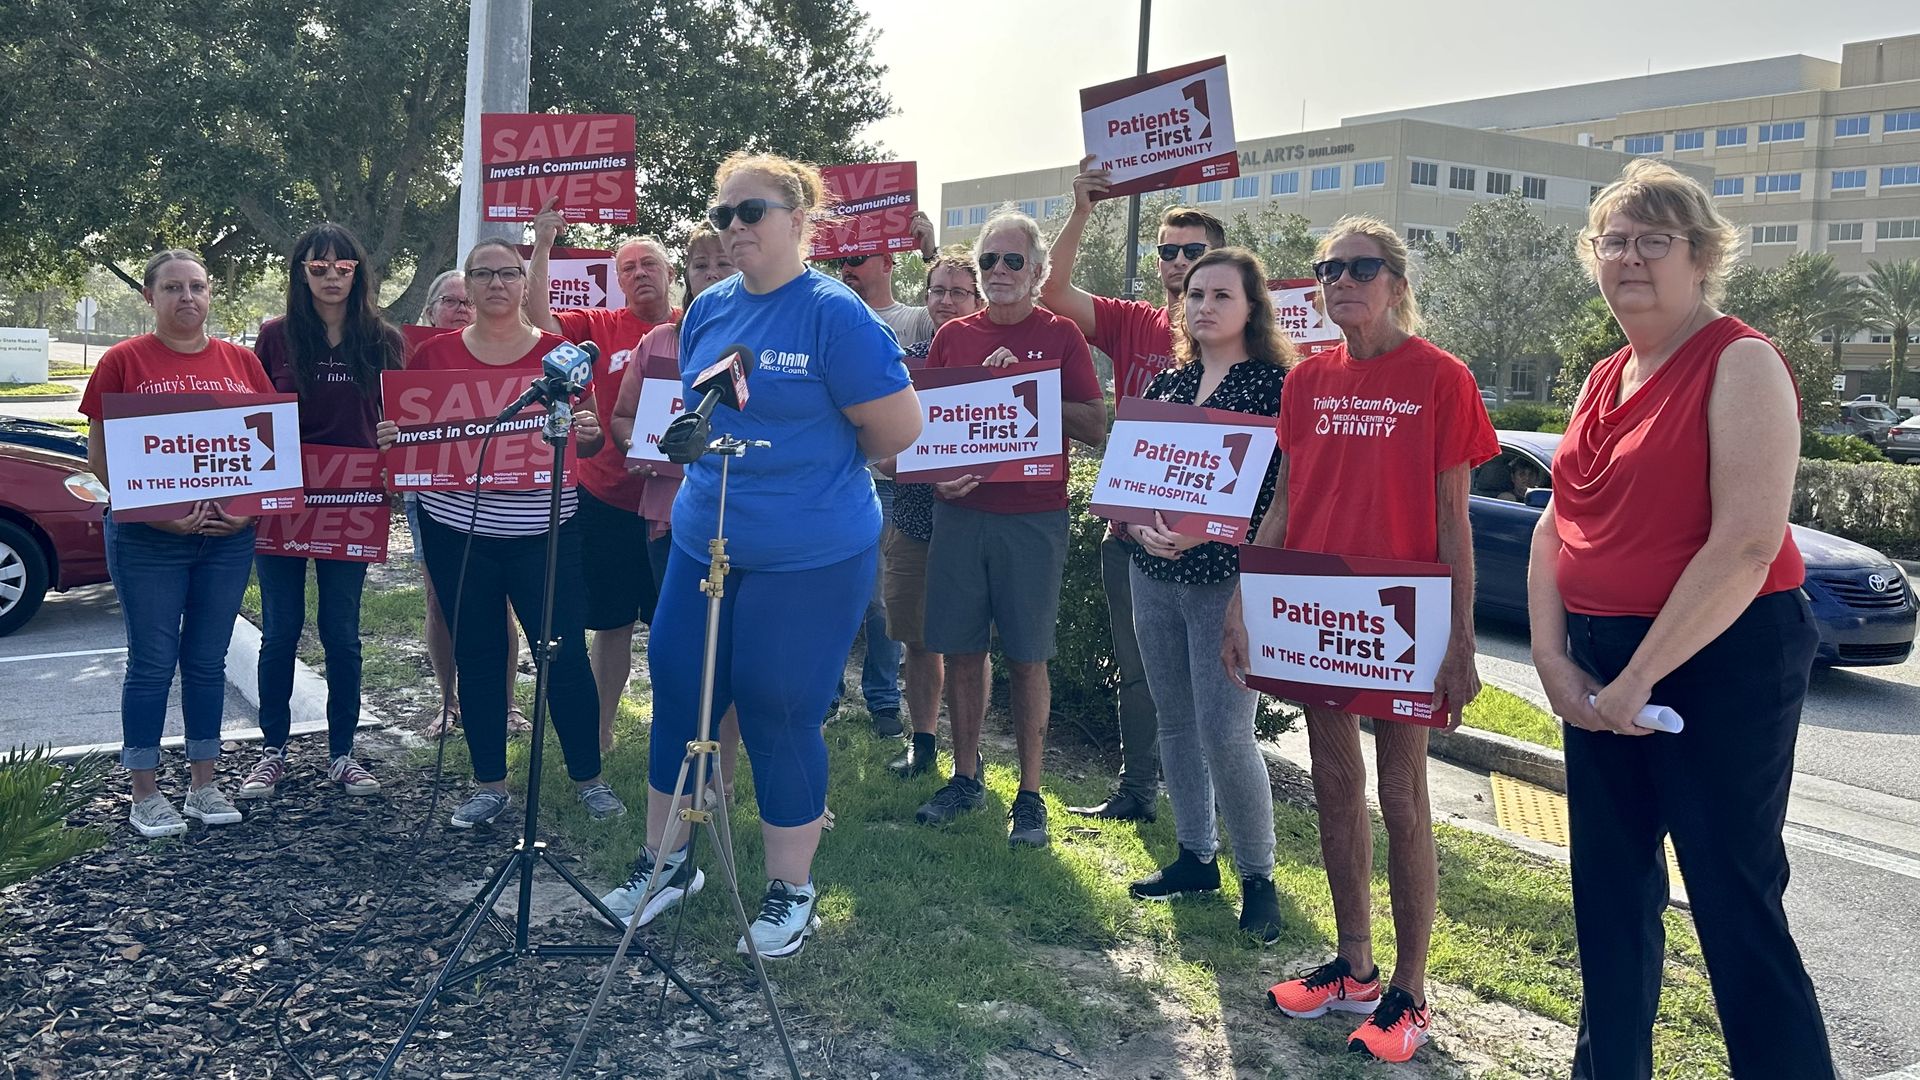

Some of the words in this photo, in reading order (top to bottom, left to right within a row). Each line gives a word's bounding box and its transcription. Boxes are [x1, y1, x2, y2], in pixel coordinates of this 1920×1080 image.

[1108, 108, 1190, 138] Patients
[490, 119, 618, 164] SAVE
[1145, 125, 1192, 150] First
[1102, 160, 1112, 171] IN
[1116, 156, 1138, 168] THE
[1140, 142, 1212, 164] COMMUNITY
[1262, 144, 1304, 164] ARTS
[1308, 144, 1354, 158] BUILDING
[490, 167, 525, 178] Invest
[528, 164, 539, 174] in
[543, 157, 627, 172] Communities
[496, 171, 623, 209] LIVES
[838, 195, 910, 215] Communities
[1135, 282, 1143, 290] 52
[550, 291, 590, 306] First
[760, 362, 780, 372] Pasco
[782, 366, 808, 376] County
[136, 374, 186, 394] Trinity's
[186, 374, 223, 391] Team
[928, 403, 1018, 422] Patients
[1313, 396, 1348, 412] Trinity's
[1350, 396, 1382, 410] Team
[1382, 398, 1422, 415] Ryder
[396, 430, 442, 443] Invest
[446, 426, 461, 438] in
[968, 422, 1018, 440] First
[1332, 422, 1396, 438] TRINITY
[144, 434, 251, 454] Patients
[404, 432, 552, 476] LIVES
[916, 445, 929, 455] IN
[933, 444, 958, 454] THE
[960, 441, 1038, 453] COMMUNITY
[194, 454, 252, 473] First
[1133, 439, 1221, 470] Patients
[128, 479, 143, 490] IN
[147, 478, 176, 490] THE
[180, 476, 252, 488] HOSPITAL
[1164, 465, 1216, 491] First
[304, 492, 383, 504] ommunities
[1108, 477, 1122, 489] IN
[1124, 480, 1146, 493] THE
[1148, 485, 1208, 506] HOSPITAL
[1272, 596, 1385, 635] Patients
[1318, 629, 1384, 661] First
[1262, 644, 1275, 659] IN
[1278, 648, 1306, 666] THE
[1309, 655, 1414, 683] COMMUNITY
